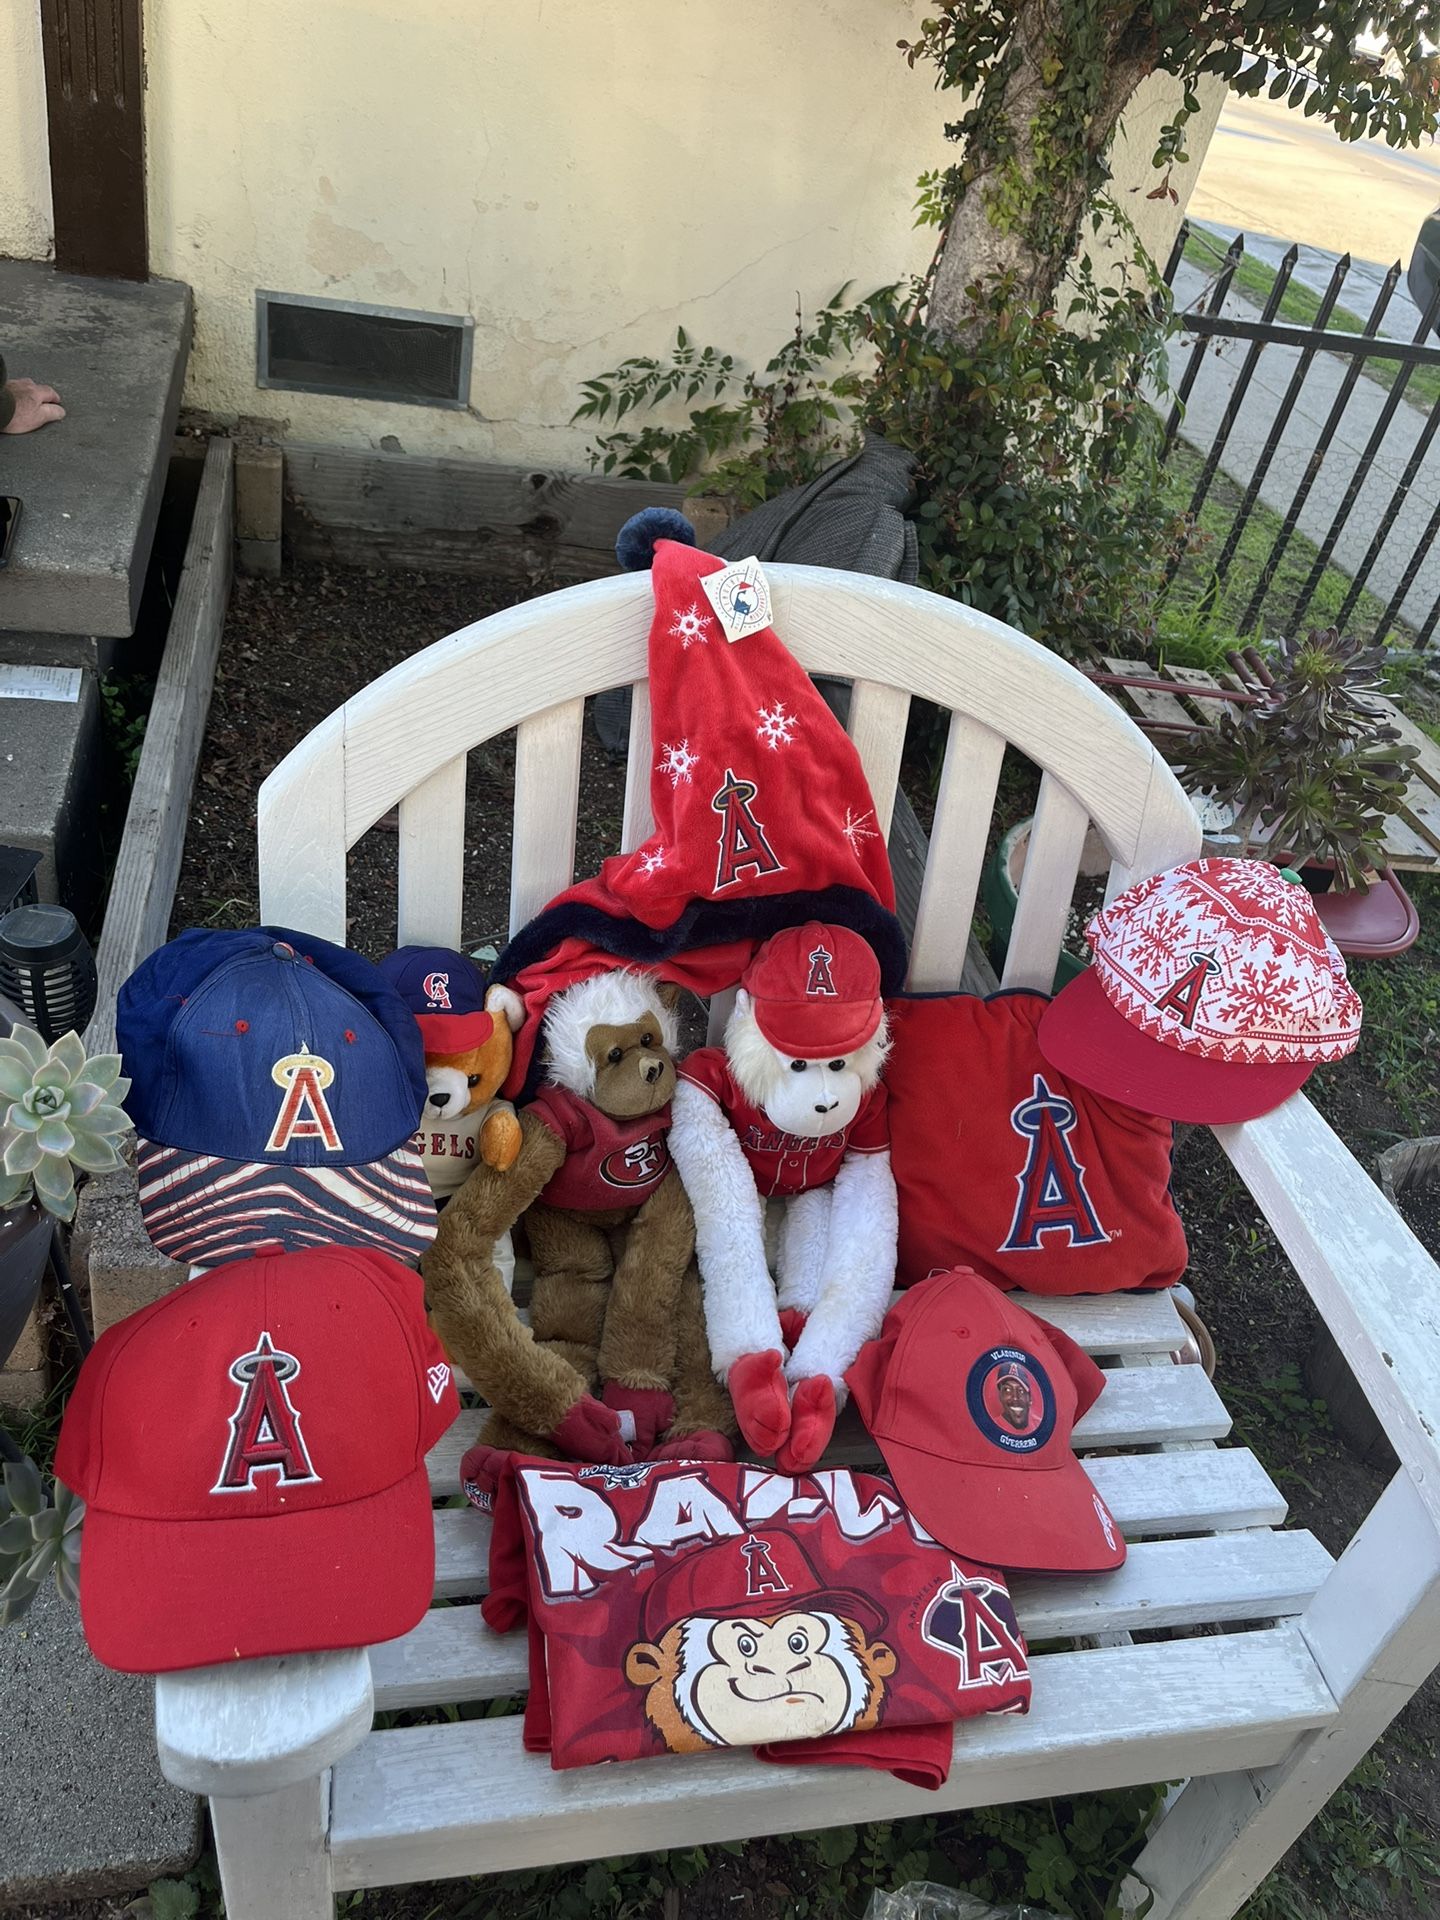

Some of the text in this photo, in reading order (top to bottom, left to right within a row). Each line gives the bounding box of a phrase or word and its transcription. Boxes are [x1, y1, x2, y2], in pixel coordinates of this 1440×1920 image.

[712, 768, 788, 894] A
[806, 944, 838, 995] A
[1153, 949, 1222, 1033] A
[264, 1040, 344, 1152] A
[408, 1132, 475, 1159] GELS
[624, 1134, 662, 1177] SF
[996, 1074, 1112, 1252] A
[1008, 1363, 1019, 1377] A
[209, 1331, 323, 1494] A
[518, 1468, 938, 1598] RALL
[740, 1534, 789, 1596] A
[908, 1576, 943, 1630] ANAHEIM
[942, 1560, 1031, 1690] A
